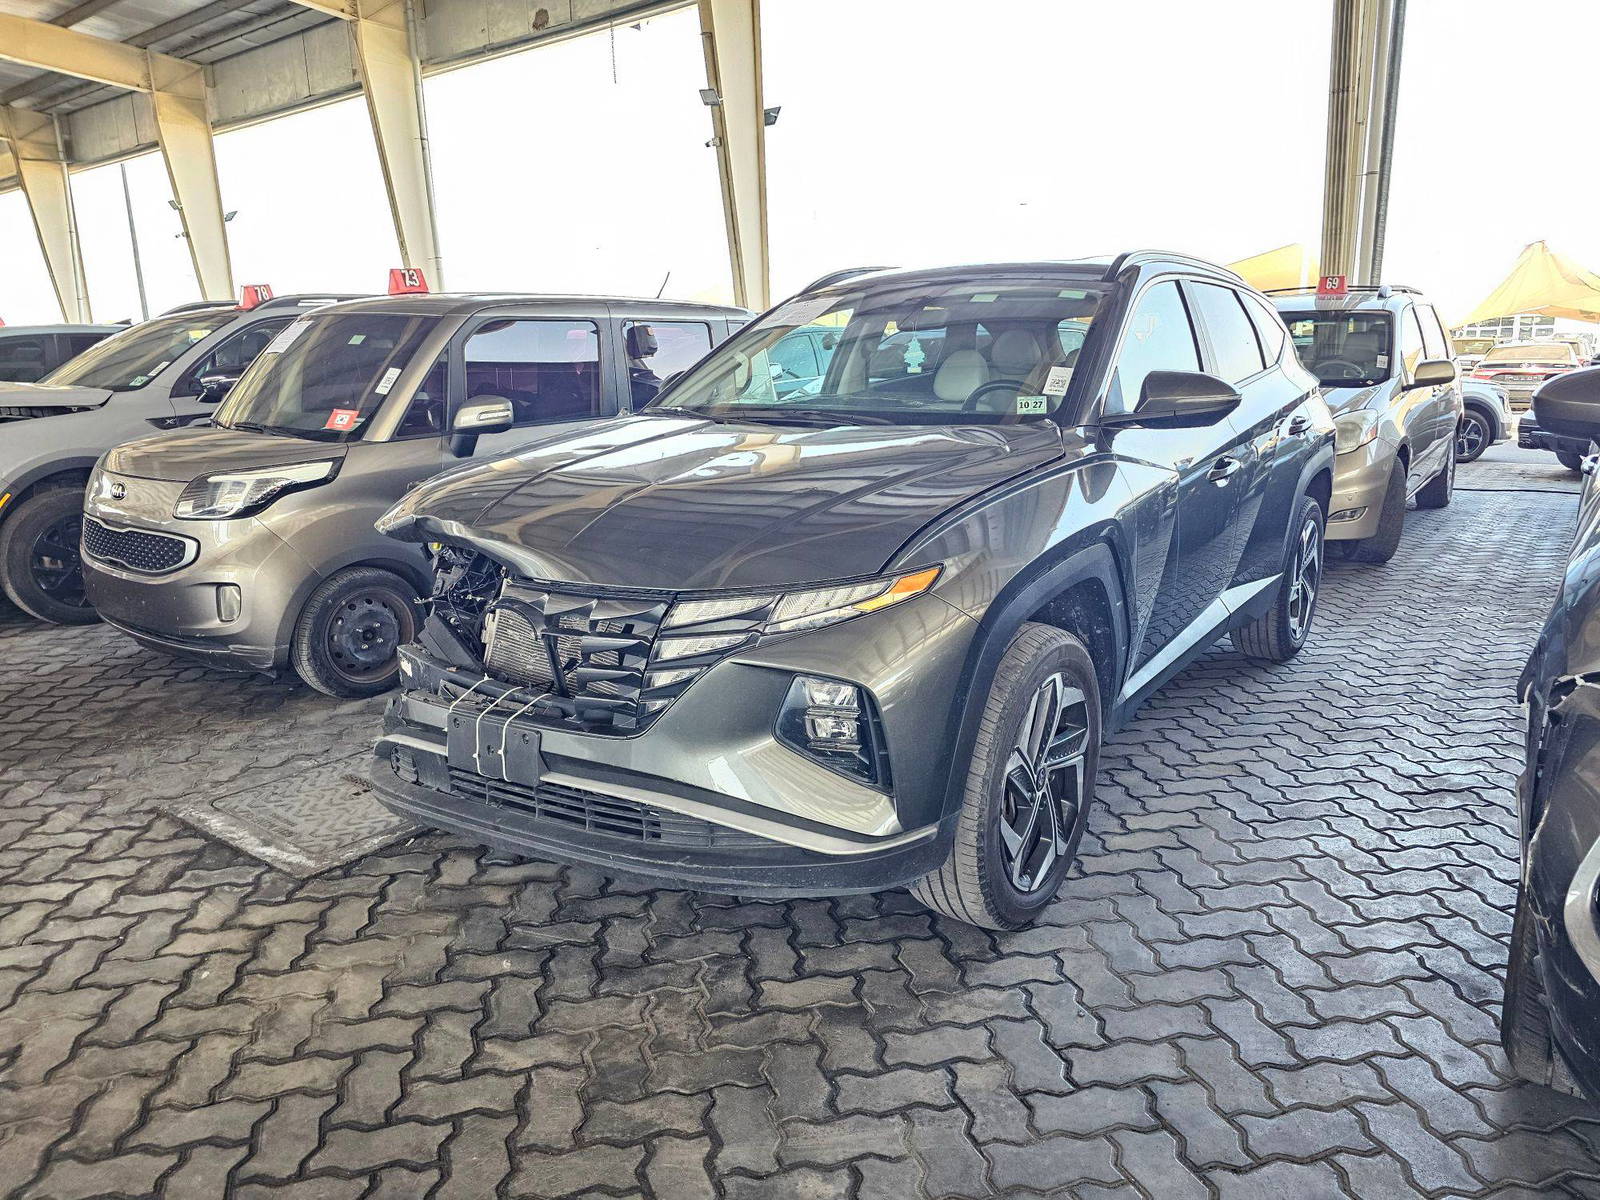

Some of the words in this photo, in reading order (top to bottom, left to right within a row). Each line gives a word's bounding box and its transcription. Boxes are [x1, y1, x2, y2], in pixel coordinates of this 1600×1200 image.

[401, 270, 420, 287] 73
[1326, 277, 1339, 289] 69
[254, 285, 270, 301] 78
